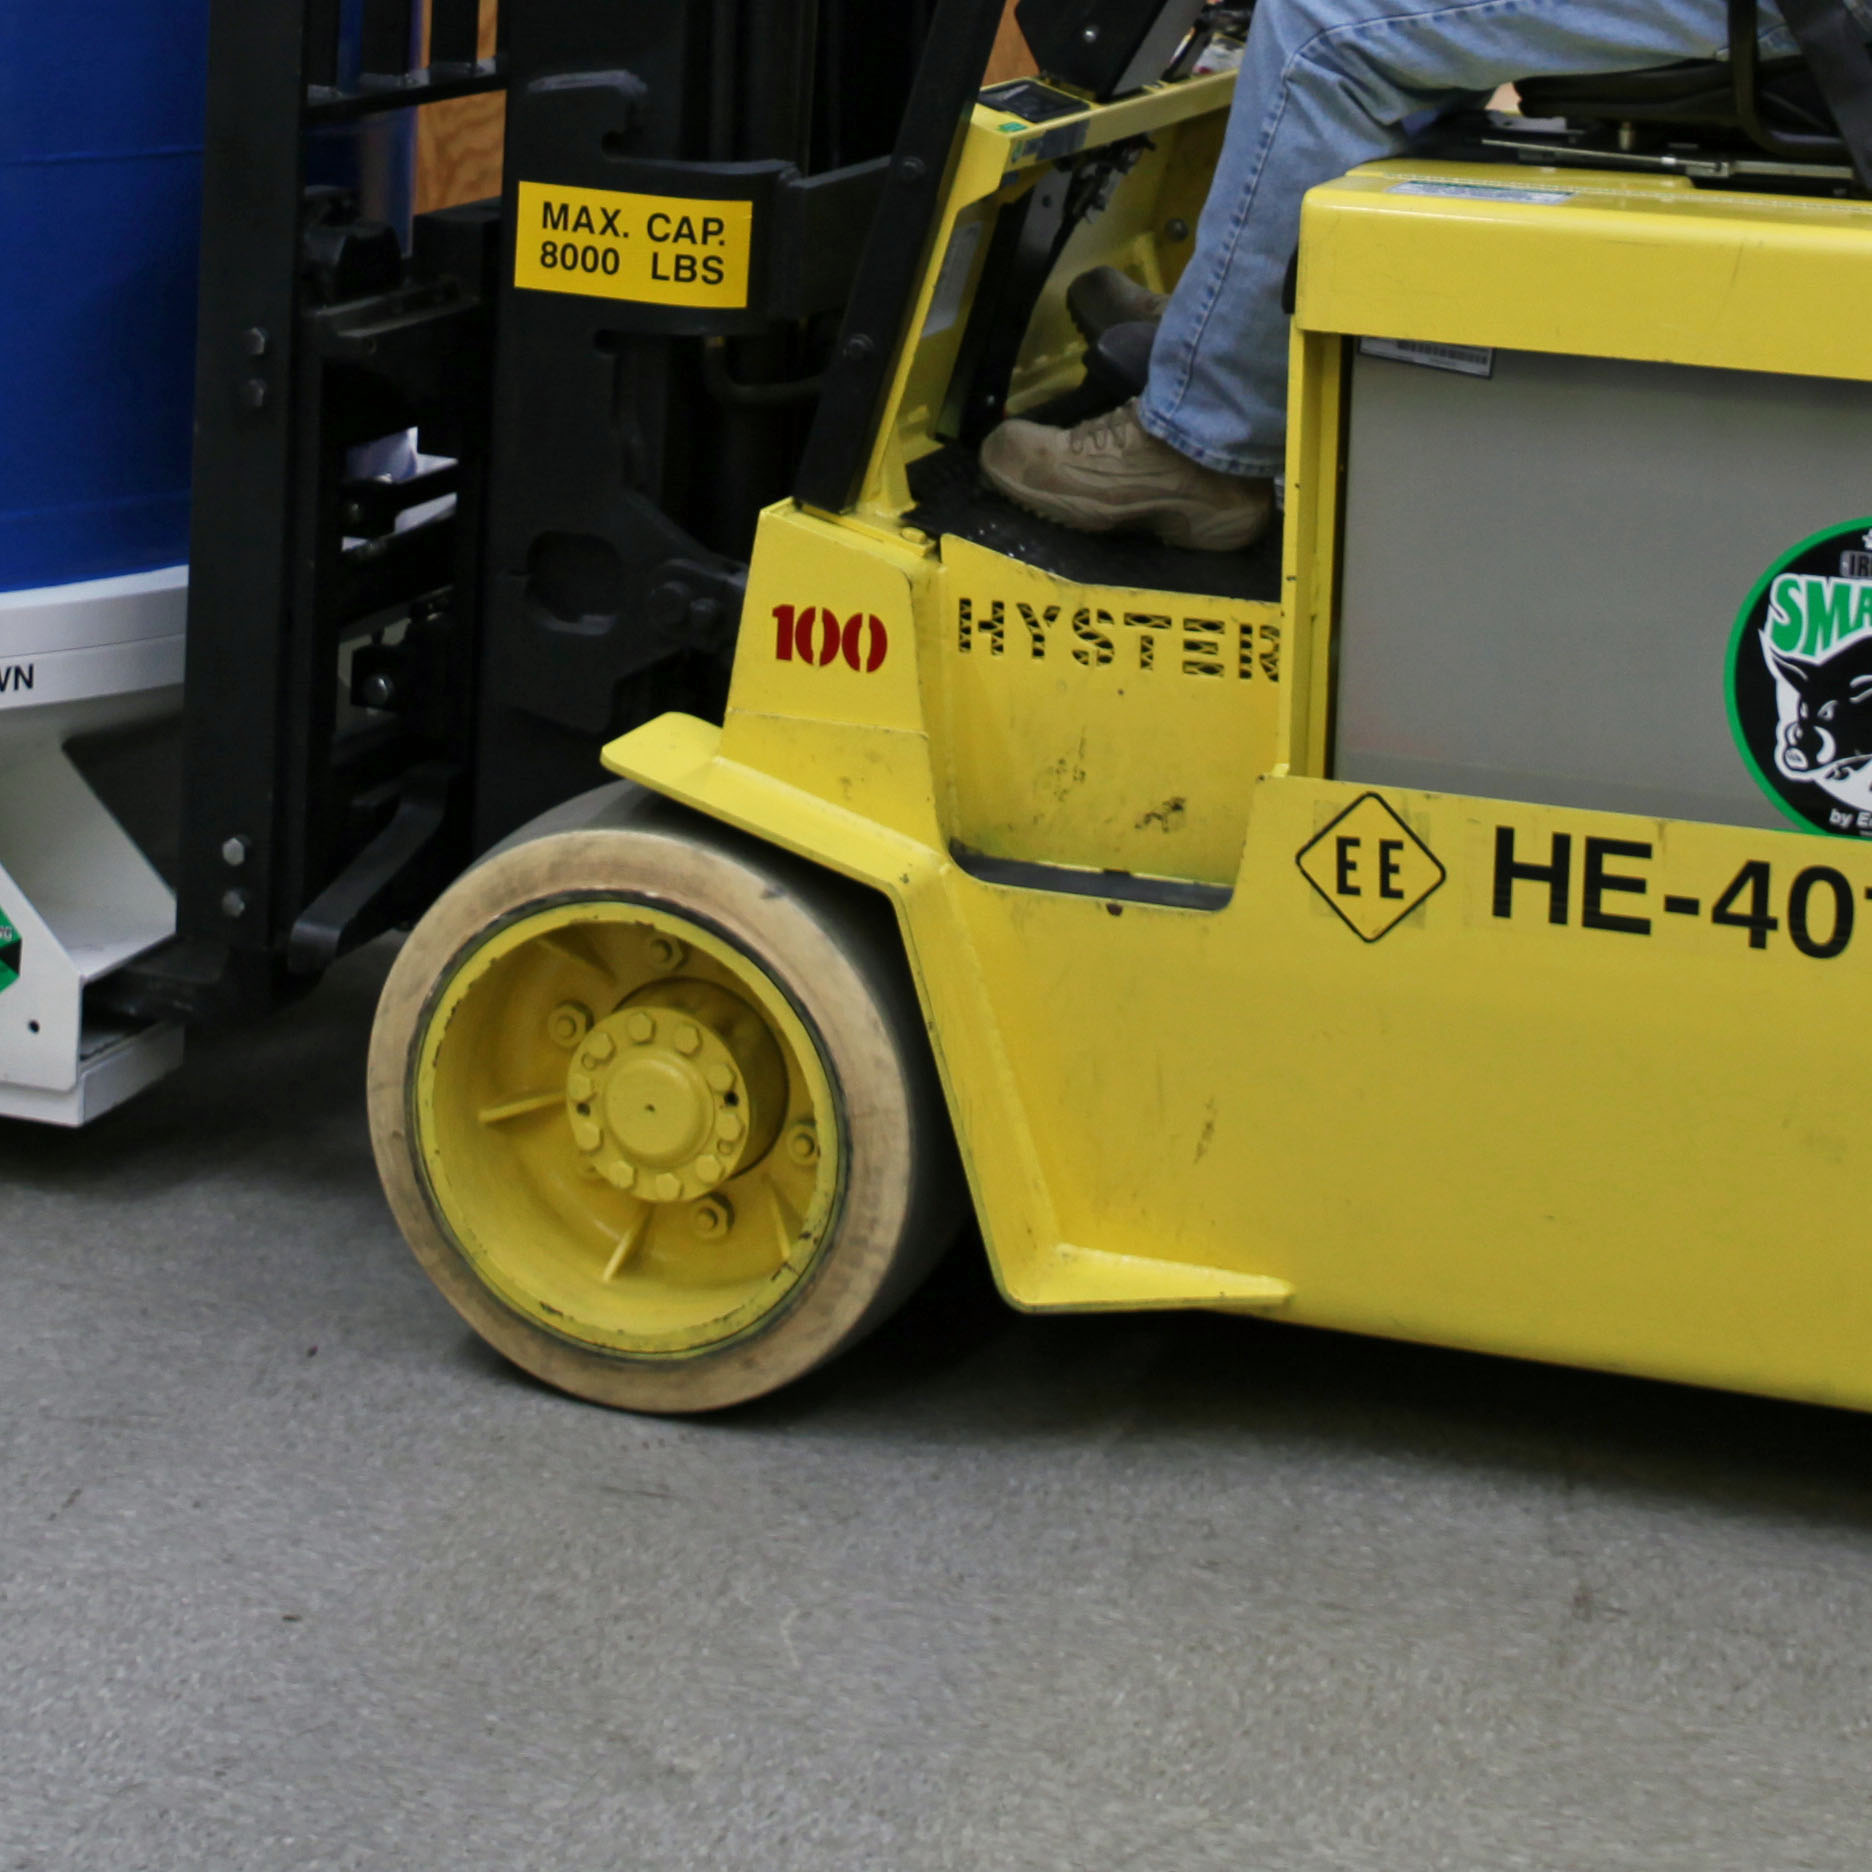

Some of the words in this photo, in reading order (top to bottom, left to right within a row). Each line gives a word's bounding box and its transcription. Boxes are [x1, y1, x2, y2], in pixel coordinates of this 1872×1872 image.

[541, 200, 629, 239] MAX.
[645, 213, 726, 248] CAP.
[540, 242, 620, 275] 8000
[650, 251, 725, 285] LBS
[772, 604, 888, 673] 100
[958, 597, 1280, 683] HYSTER
[1829, 808, 1853, 827] by
